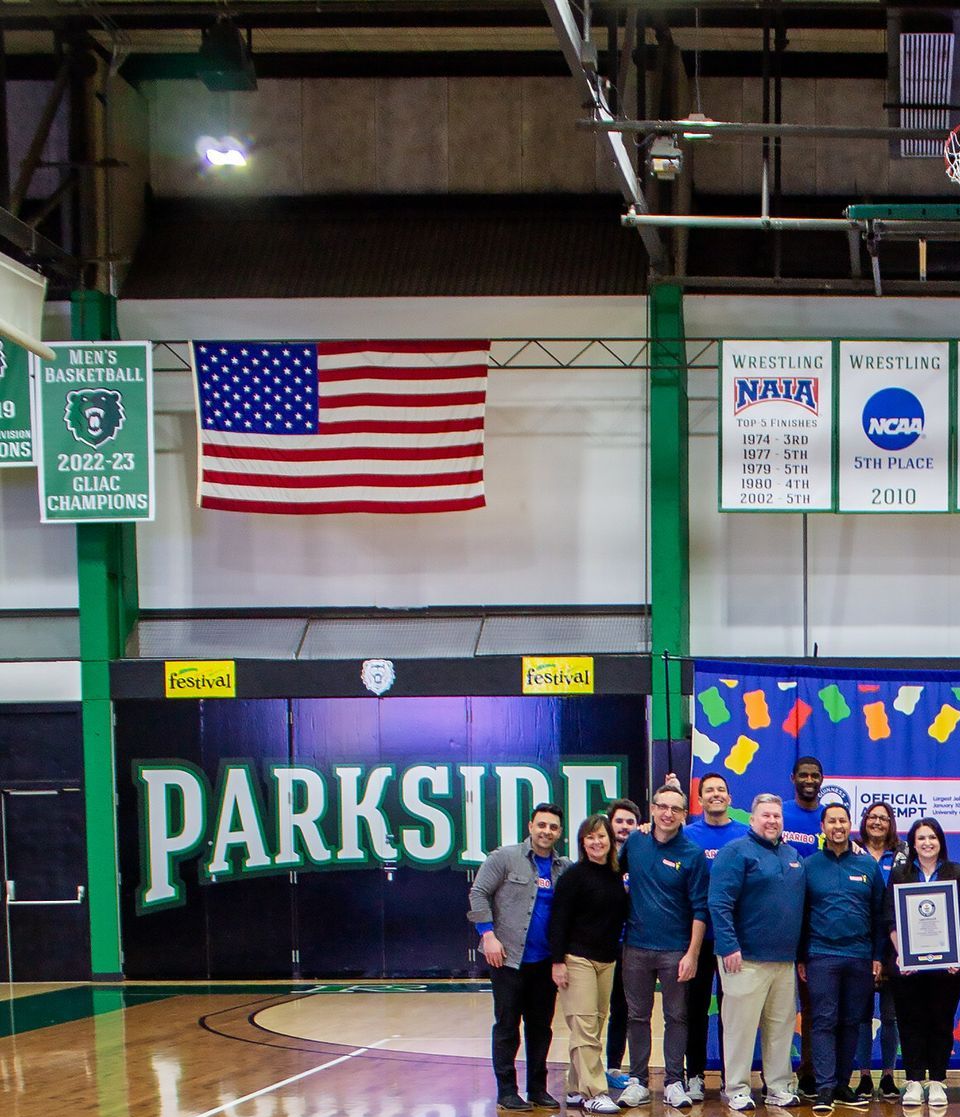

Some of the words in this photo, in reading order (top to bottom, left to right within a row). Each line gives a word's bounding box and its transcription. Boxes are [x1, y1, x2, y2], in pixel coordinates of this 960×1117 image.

[69, 350, 117, 364] MEN'S
[732, 355, 823, 369] WRESTLING
[850, 355, 941, 370] WRESTLING
[44, 367, 144, 383] BASKETBALL
[736, 379, 816, 409] NAIA
[736, 418, 757, 427] TOP
[761, 418, 767, 427] 5
[770, 418, 818, 428] FINISHES
[868, 418, 923, 435] NCAA
[743, 434, 770, 445] 1974
[783, 434, 809, 445] 3RD
[743, 449, 771, 460] 1977
[783, 449, 808, 460] 5TH
[58, 453, 135, 471] 2022-23
[742, 463, 771, 474] 1979
[784, 463, 808, 474] 5TH
[854, 456, 882, 469] 5TH
[887, 456, 934, 469] PLACE
[72, 476, 120, 492] GLIAC
[741, 478, 772, 489] 1980
[785, 479, 809, 489] 4TH
[47, 493, 148, 511] CHAMPIONS
[740, 493, 773, 504] 2002
[786, 494, 810, 504] 5TH
[871, 488, 916, 505] 2010
[168, 672, 231, 689] festival
[527, 668, 590, 685] festival
[860, 793, 927, 805] OFFICIAL
[782, 831, 815, 844] HARIBO
